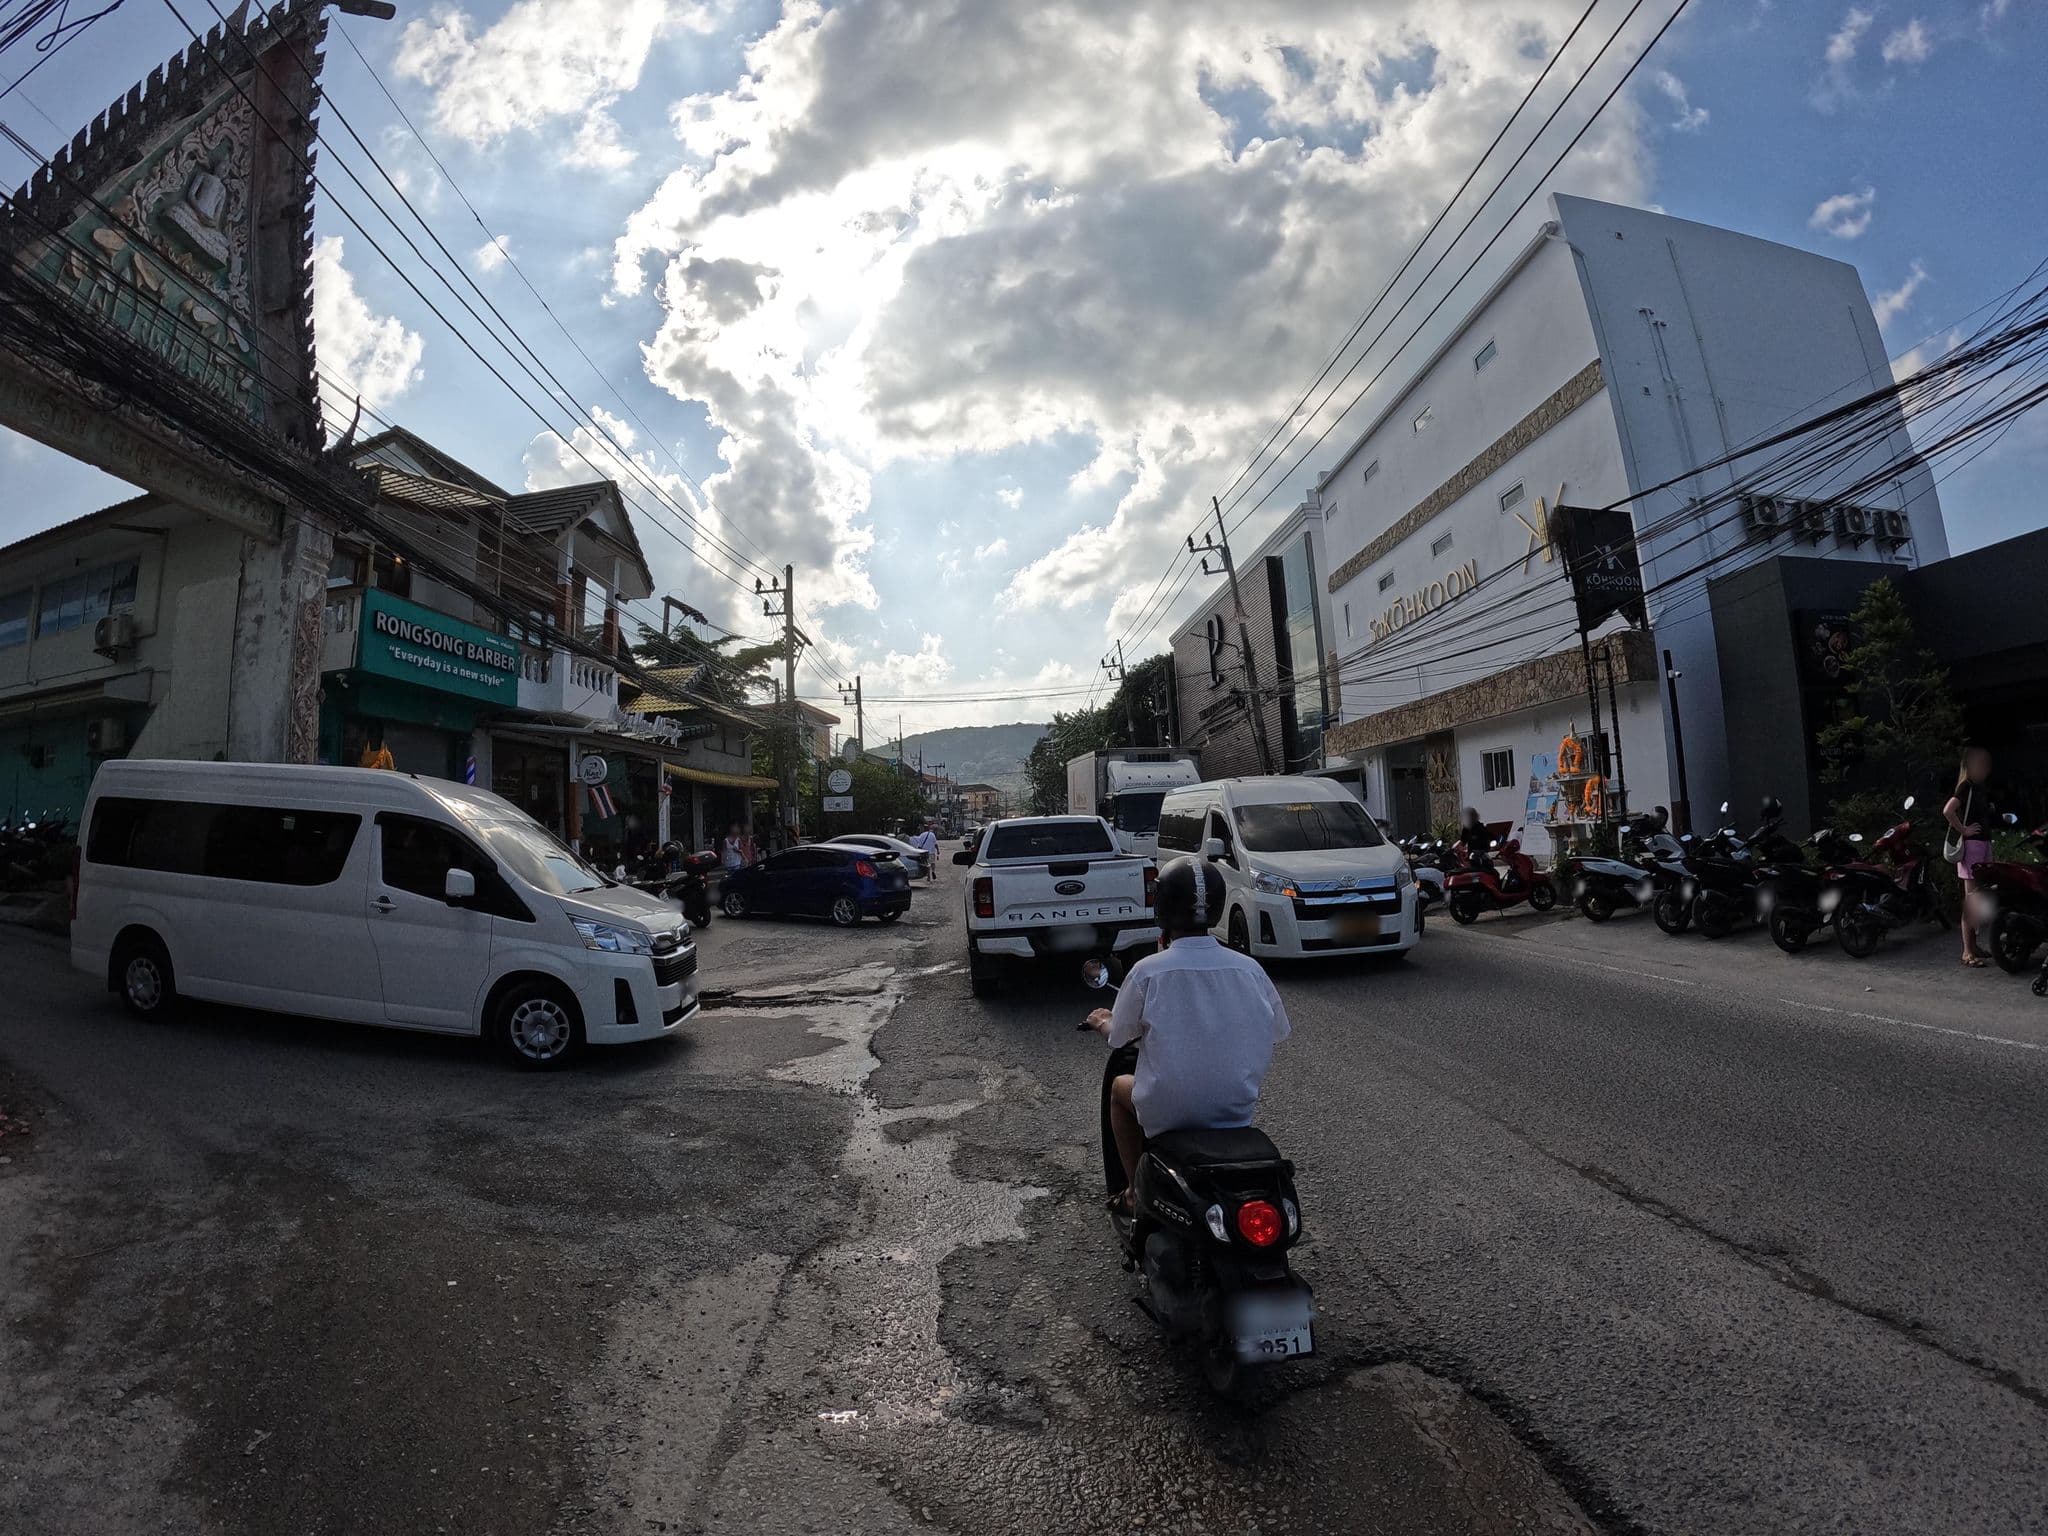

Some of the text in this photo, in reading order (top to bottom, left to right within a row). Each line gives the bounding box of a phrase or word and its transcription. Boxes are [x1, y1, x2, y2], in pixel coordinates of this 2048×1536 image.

[376, 611, 515, 672] RONGSONG BARBER
[443, 660, 451, 672] is
[453, 667, 458, 675] a
[460, 667, 478, 680] new
[1008, 905, 1133, 921] RANGER
